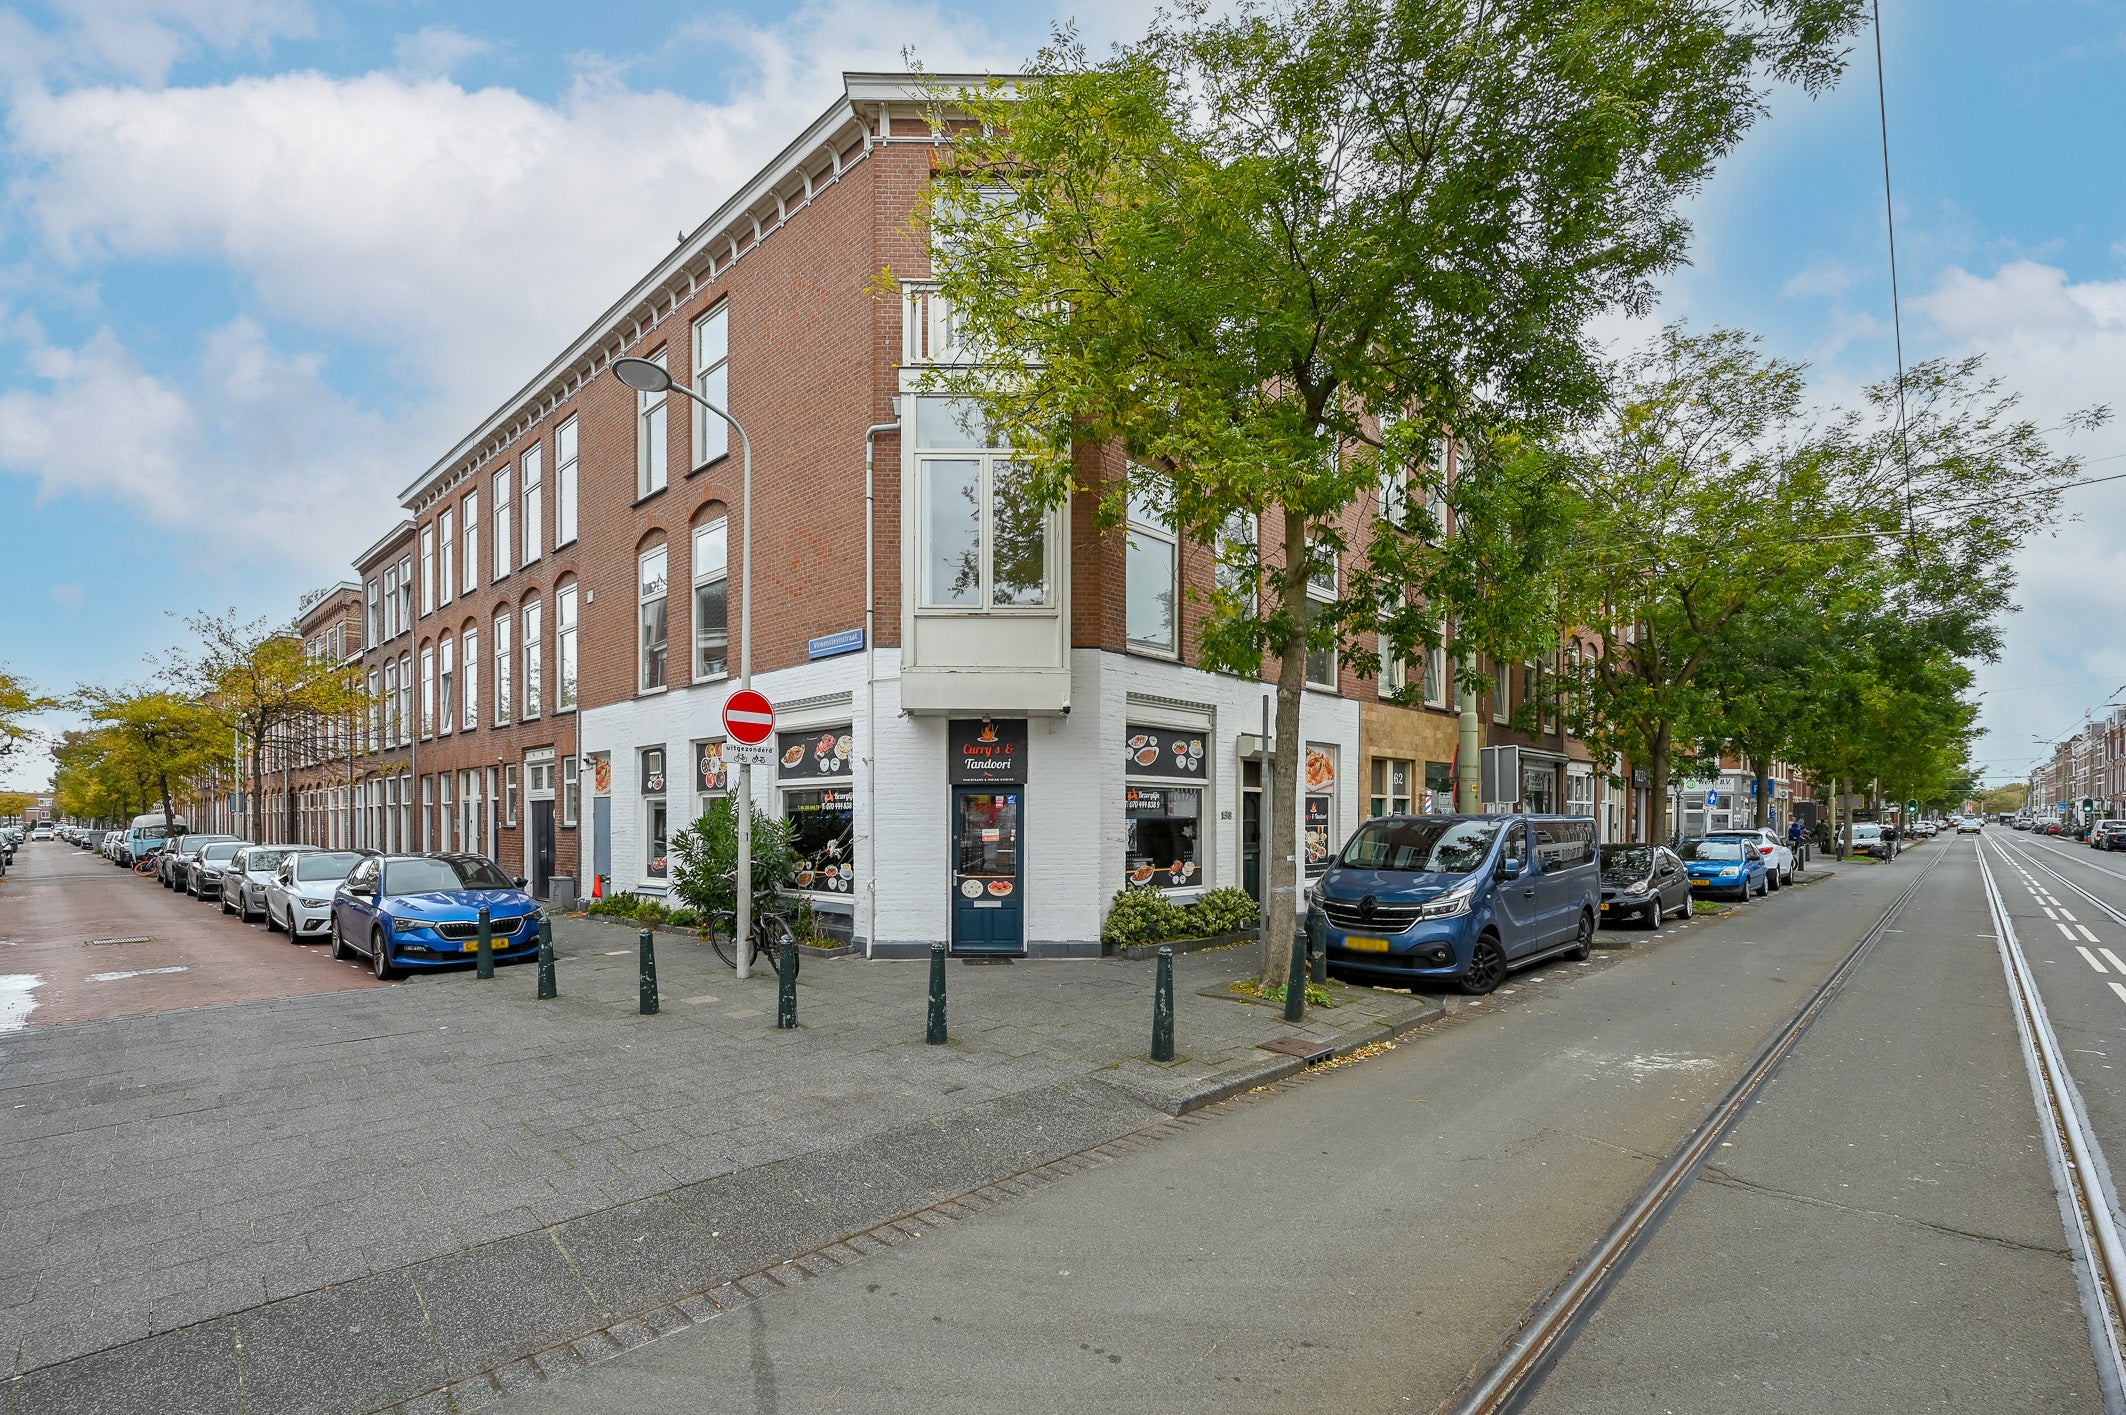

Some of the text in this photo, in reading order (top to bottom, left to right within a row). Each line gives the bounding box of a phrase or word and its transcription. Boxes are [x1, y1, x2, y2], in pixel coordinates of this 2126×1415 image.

[726, 745, 773, 754] uitgezonderd
[963, 743, 1014, 758] Curry's &
[964, 758, 1012, 770] Tandoori
[1393, 772, 1404, 785] 62
